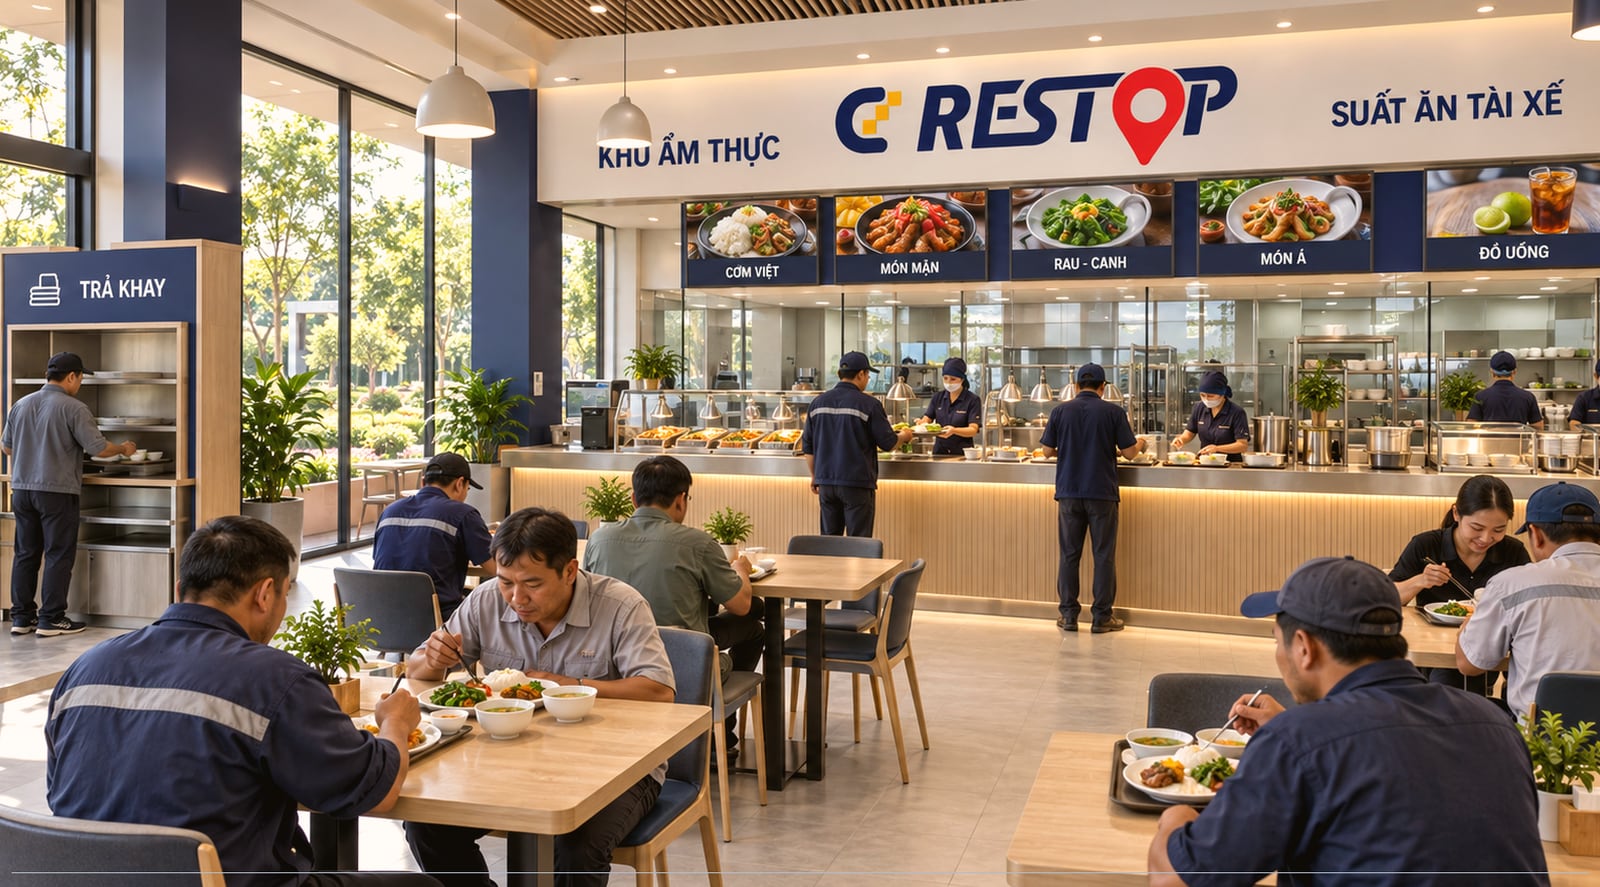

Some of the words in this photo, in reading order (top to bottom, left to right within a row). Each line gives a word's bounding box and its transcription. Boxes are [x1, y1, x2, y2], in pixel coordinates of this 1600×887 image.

[1331, 88, 1406, 127] SUẤT
[1414, 90, 1457, 122] ĂN
[1467, 86, 1512, 119] TÀI
[1523, 79, 1565, 117] XẾ
[917, 65, 1238, 166] RESTOP
[598, 145, 650, 169] KHU
[658, 132, 699, 166] ẨM
[707, 132, 780, 167] THỰC
[1260, 249, 1293, 265] MÓN
[1296, 248, 1307, 265] Á
[1505, 241, 1550, 259] UỐNG
[725, 265, 751, 279] CƠM
[755, 264, 780, 280] VIỆT
[880, 259, 908, 275] MÓN
[1054, 257, 1080, 270] RAU
[1090, 256, 1127, 269] CANH
[80, 274, 114, 299] TRẢ
[119, 278, 166, 298] KHAY
